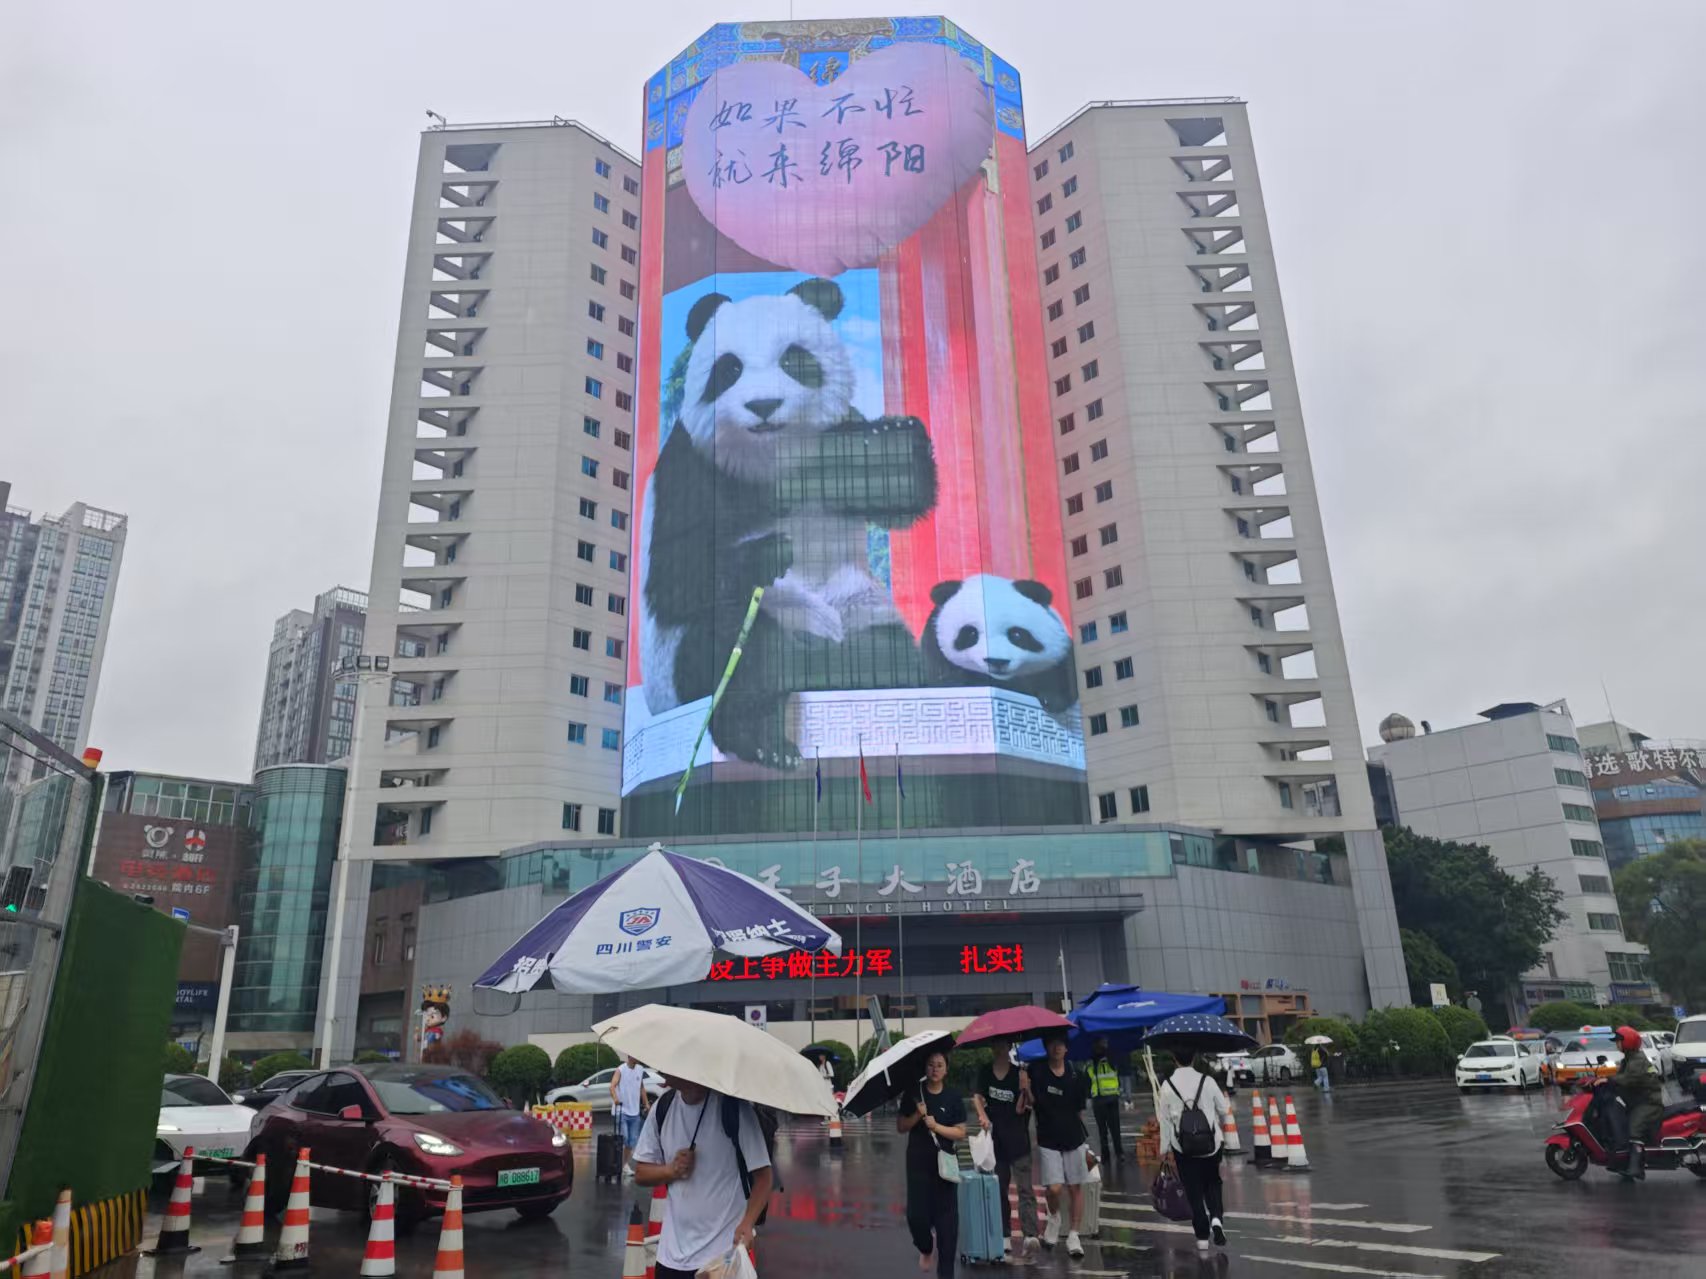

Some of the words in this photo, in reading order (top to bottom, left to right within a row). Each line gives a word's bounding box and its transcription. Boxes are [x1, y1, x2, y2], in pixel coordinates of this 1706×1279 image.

[709, 86, 924, 134] 如果不忙
[708, 138, 925, 188] 就来绵阳
[703, 856, 1040, 897] 王子大酒店
[922, 899, 1011, 912] HOTEL
